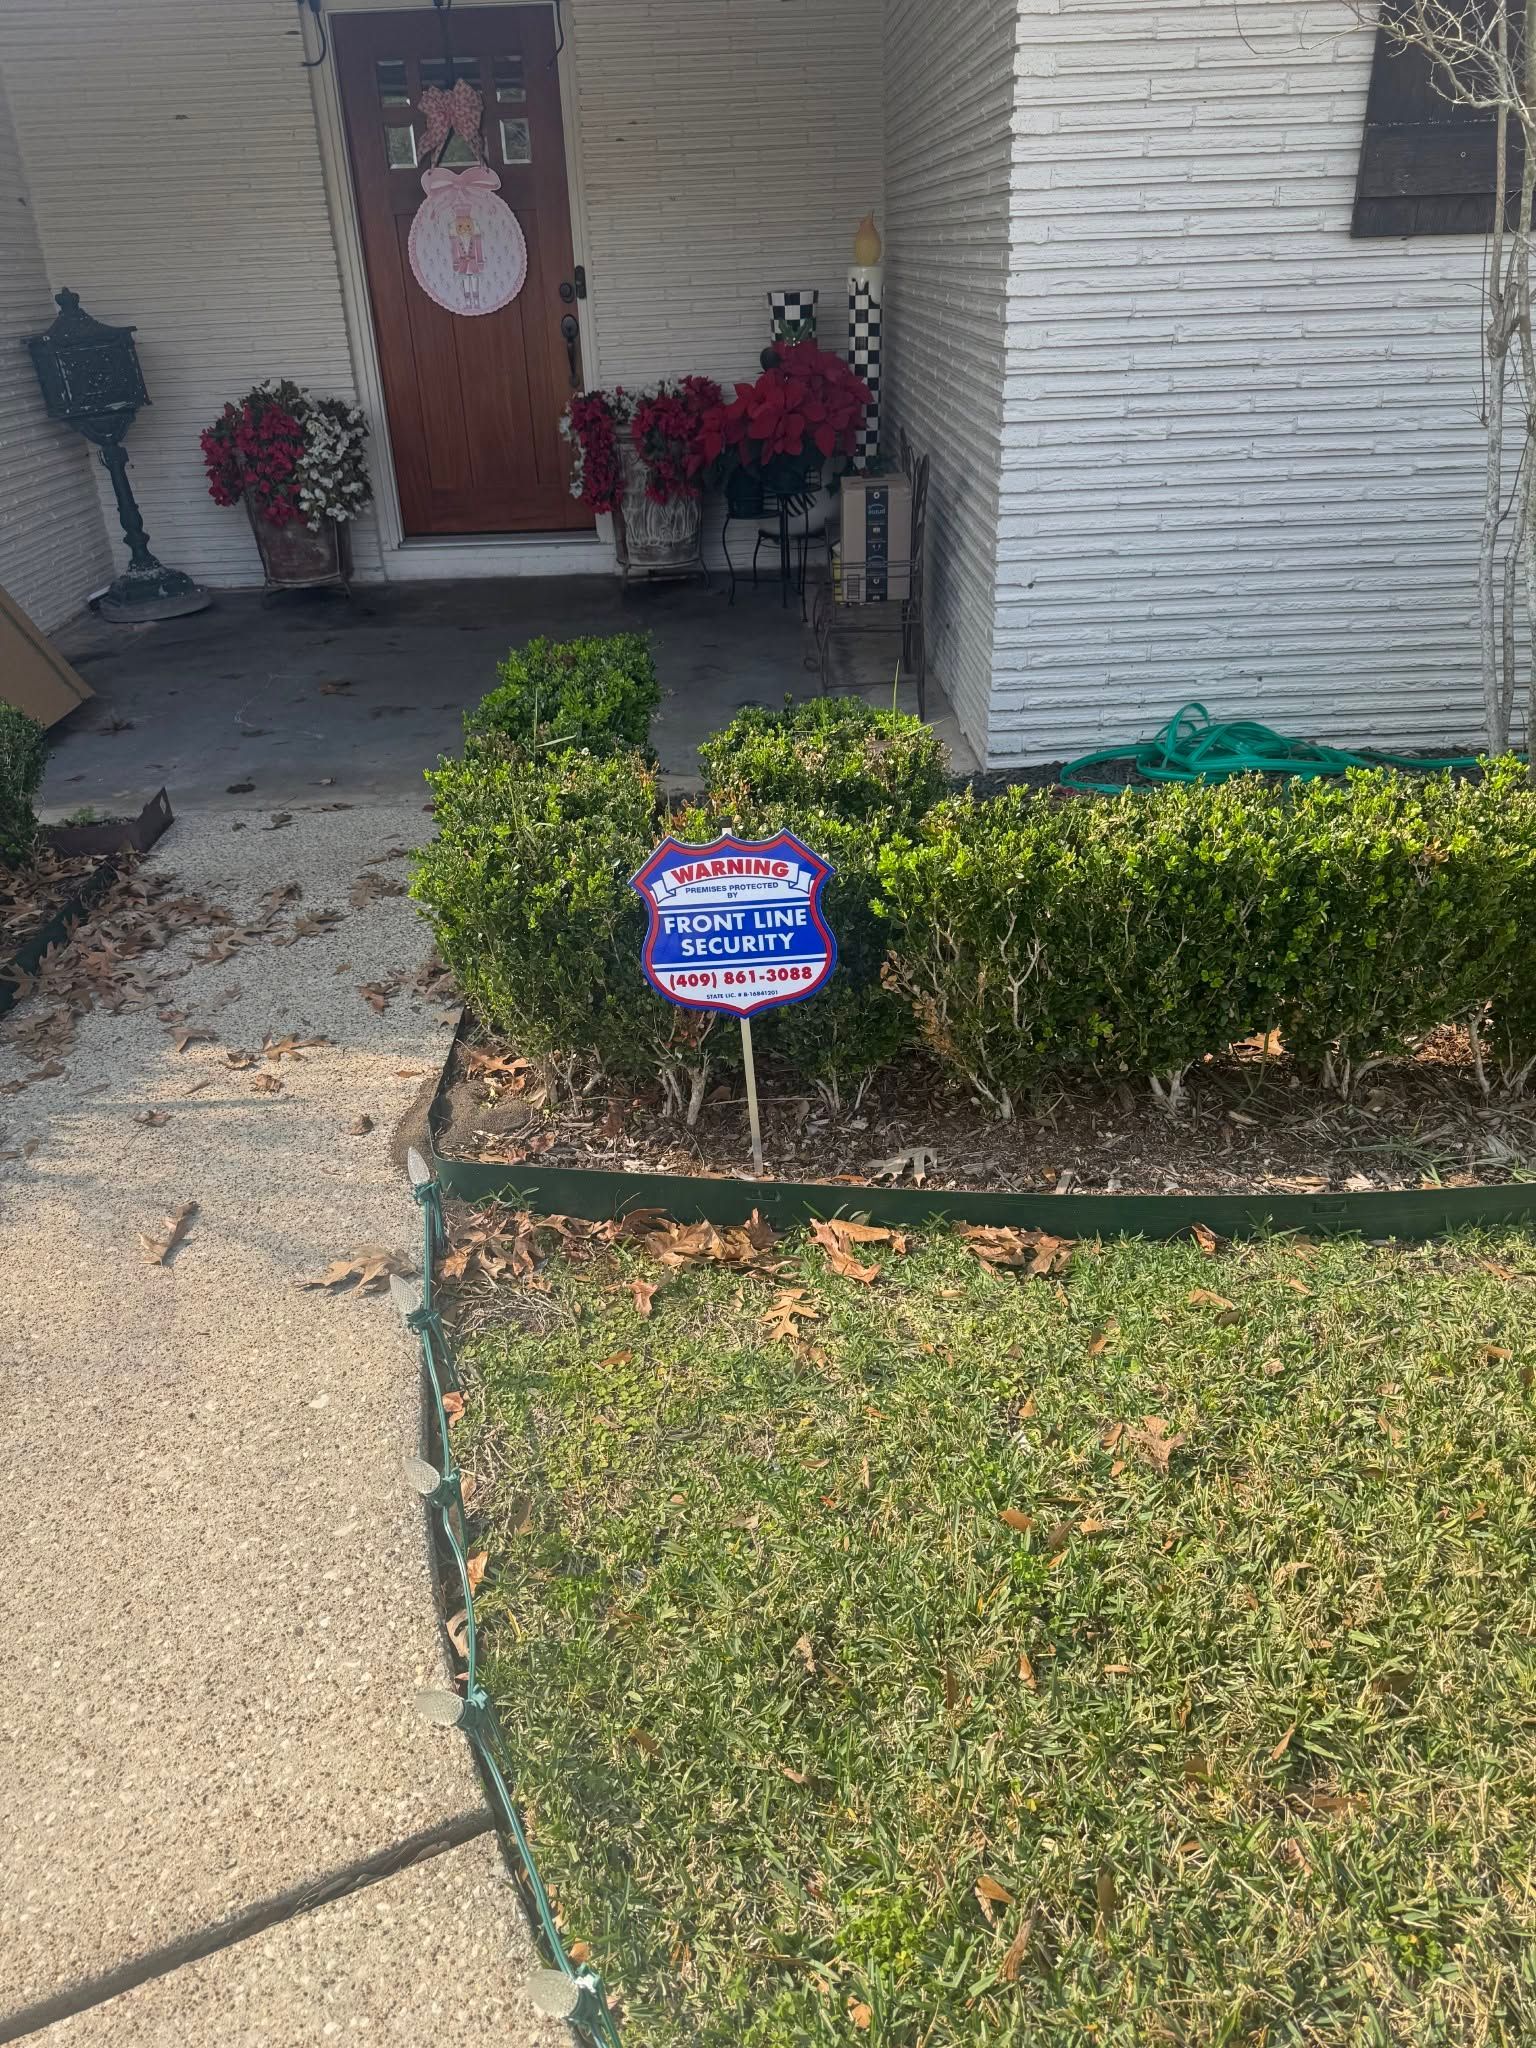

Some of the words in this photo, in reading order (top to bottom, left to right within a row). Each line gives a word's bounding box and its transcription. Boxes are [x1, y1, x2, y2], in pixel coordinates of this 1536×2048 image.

[670, 858, 790, 885] WARNING
[685, 884, 728, 894] PREMISES
[728, 881, 780, 892] PROTECTED
[726, 891, 738, 899] BY
[664, 912, 746, 935] FRONT
[754, 908, 808, 929] LINE
[681, 932, 795, 957] SECURITY
[669, 971, 718, 991] (409)
[723, 966, 813, 985] 861-3088
